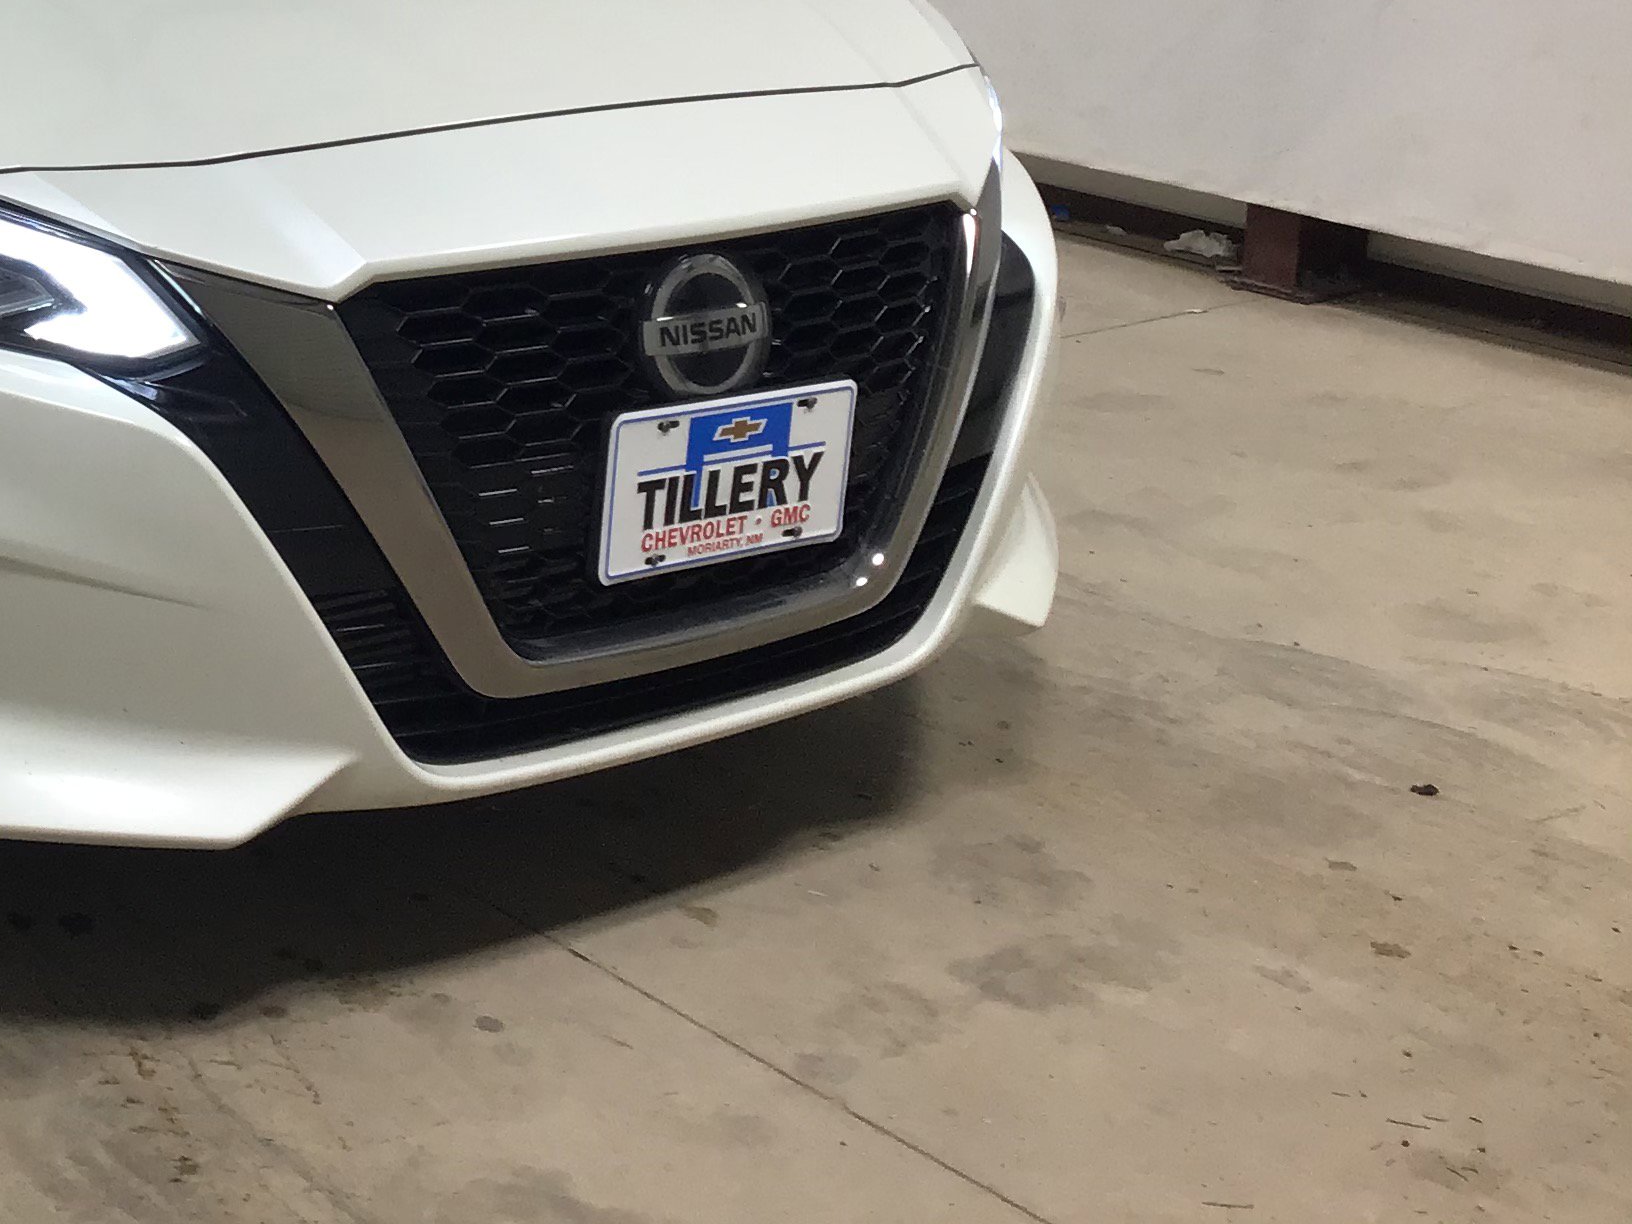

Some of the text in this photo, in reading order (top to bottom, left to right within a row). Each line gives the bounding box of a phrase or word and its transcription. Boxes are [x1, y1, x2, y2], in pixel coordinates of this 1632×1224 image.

[658, 311, 758, 348] NISSAN
[637, 450, 825, 531] TILLERY
[641, 504, 812, 553] CHEVROLET GMC
[745, 532, 764, 546] NM
